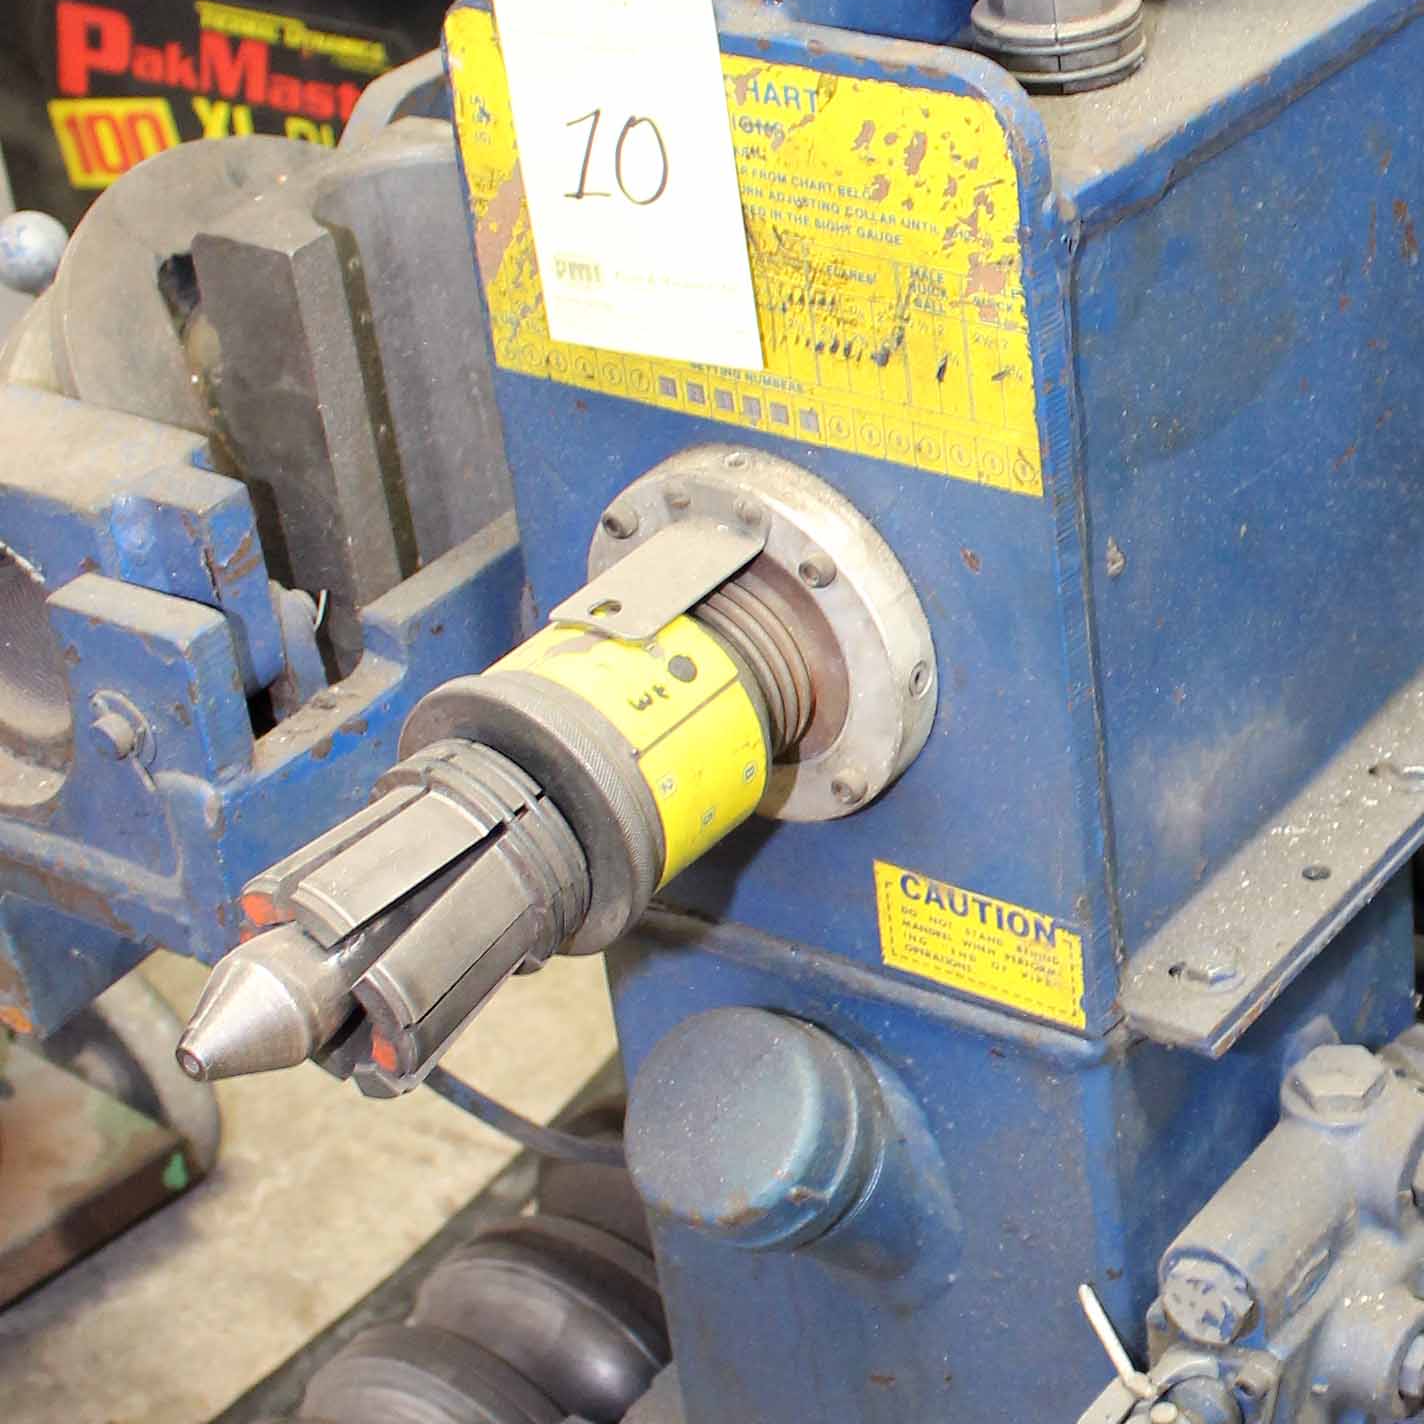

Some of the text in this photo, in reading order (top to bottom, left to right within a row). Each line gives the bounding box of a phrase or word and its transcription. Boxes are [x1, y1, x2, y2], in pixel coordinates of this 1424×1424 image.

[727, 77, 820, 114] HART
[564, 108, 669, 206] 10
[751, 167, 788, 185] FROM
[791, 175, 833, 194] CHART
[837, 185, 874, 201] BELO
[768, 191, 840, 215] ADJUSTING
[844, 205, 897, 226] COLLAR
[788, 212, 810, 226] THE
[856, 226, 904, 247] GAUGE
[900, 872, 1057, 948] CAUTION
